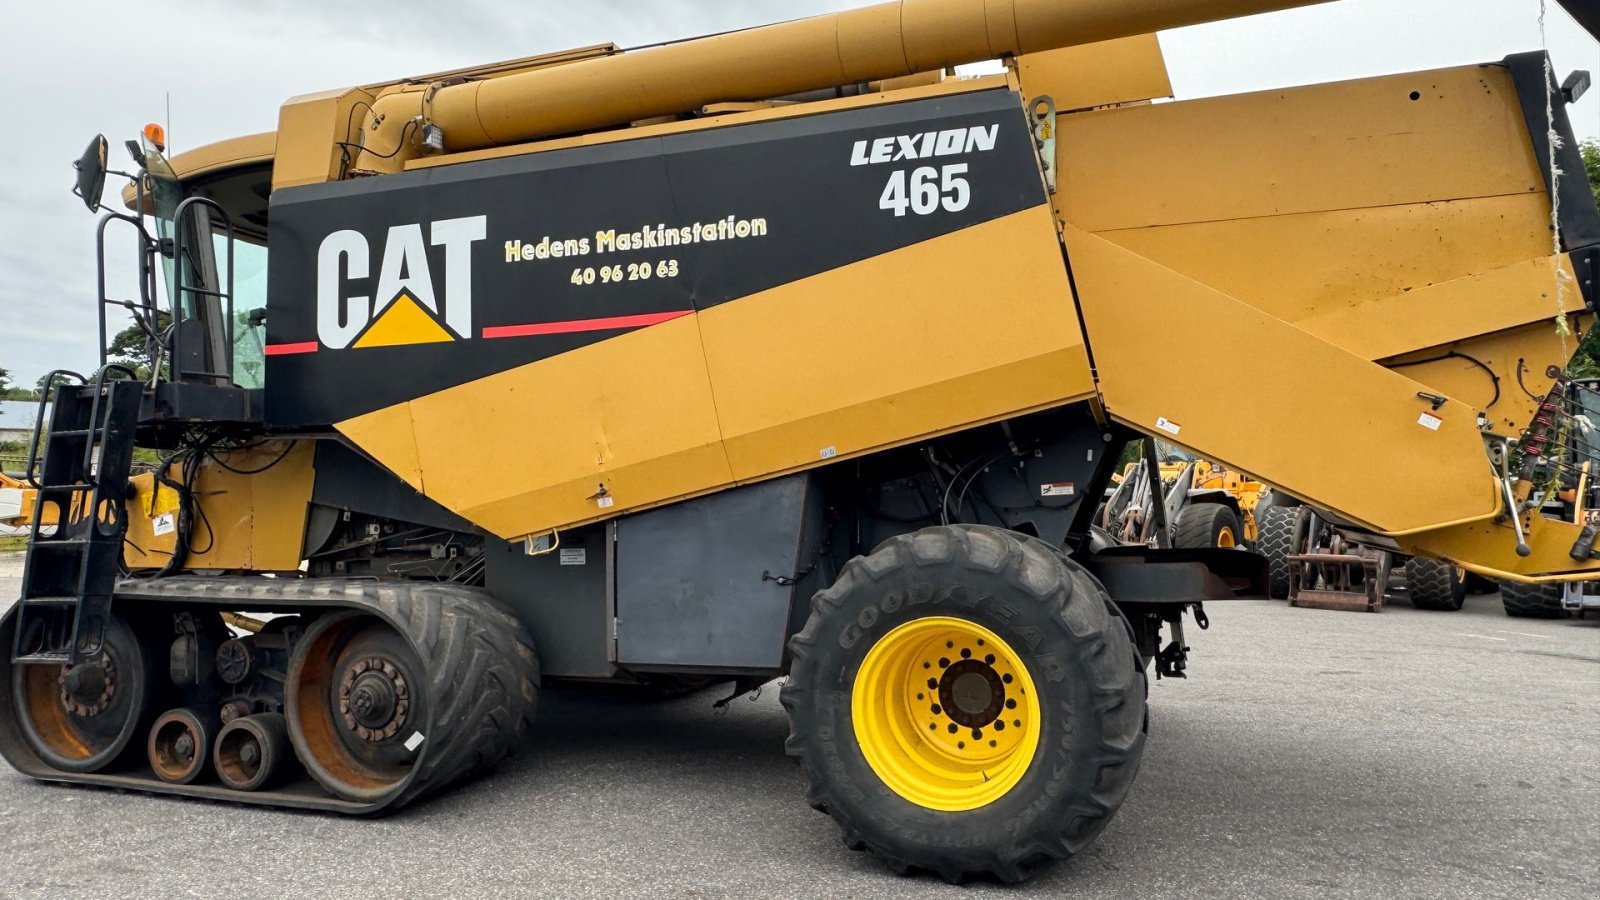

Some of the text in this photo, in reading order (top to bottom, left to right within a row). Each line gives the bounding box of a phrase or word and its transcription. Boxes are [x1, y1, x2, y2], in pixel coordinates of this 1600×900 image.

[850, 124, 999, 166] LEXION
[879, 163, 970, 217] 465
[505, 215, 767, 262] Hedens Maskinstation
[317, 215, 487, 349] CAT
[571, 259, 679, 286] 40 96 20 63
[838, 582, 1066, 683] GOODYEAR
